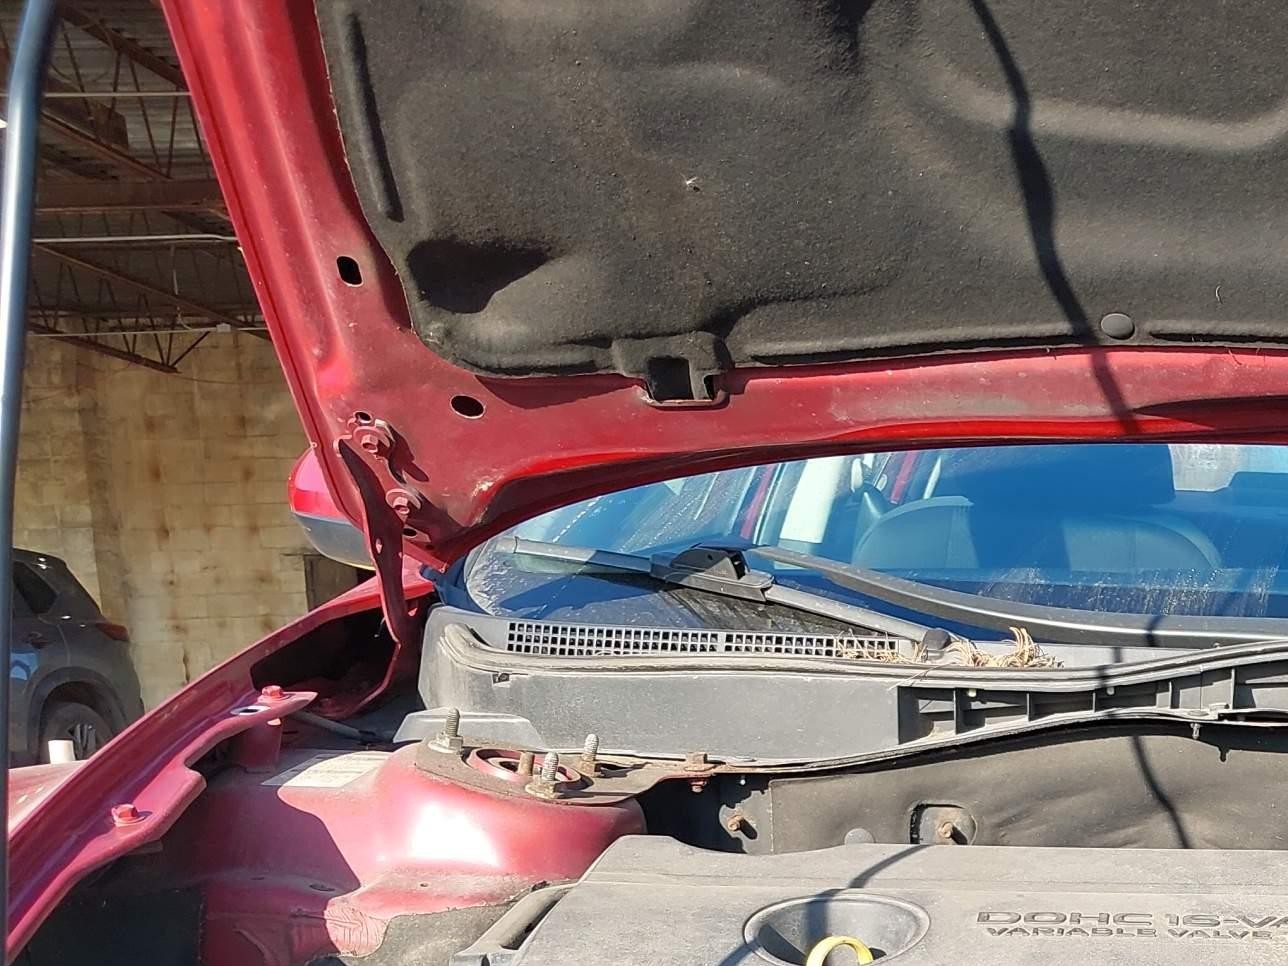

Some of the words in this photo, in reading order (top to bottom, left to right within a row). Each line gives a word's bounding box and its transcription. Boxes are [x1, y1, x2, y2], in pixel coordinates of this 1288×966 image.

[976, 911, 1153, 926] DOHC
[986, 927, 1158, 938] VARIABLE
[1167, 929, 1273, 940] VALVE
